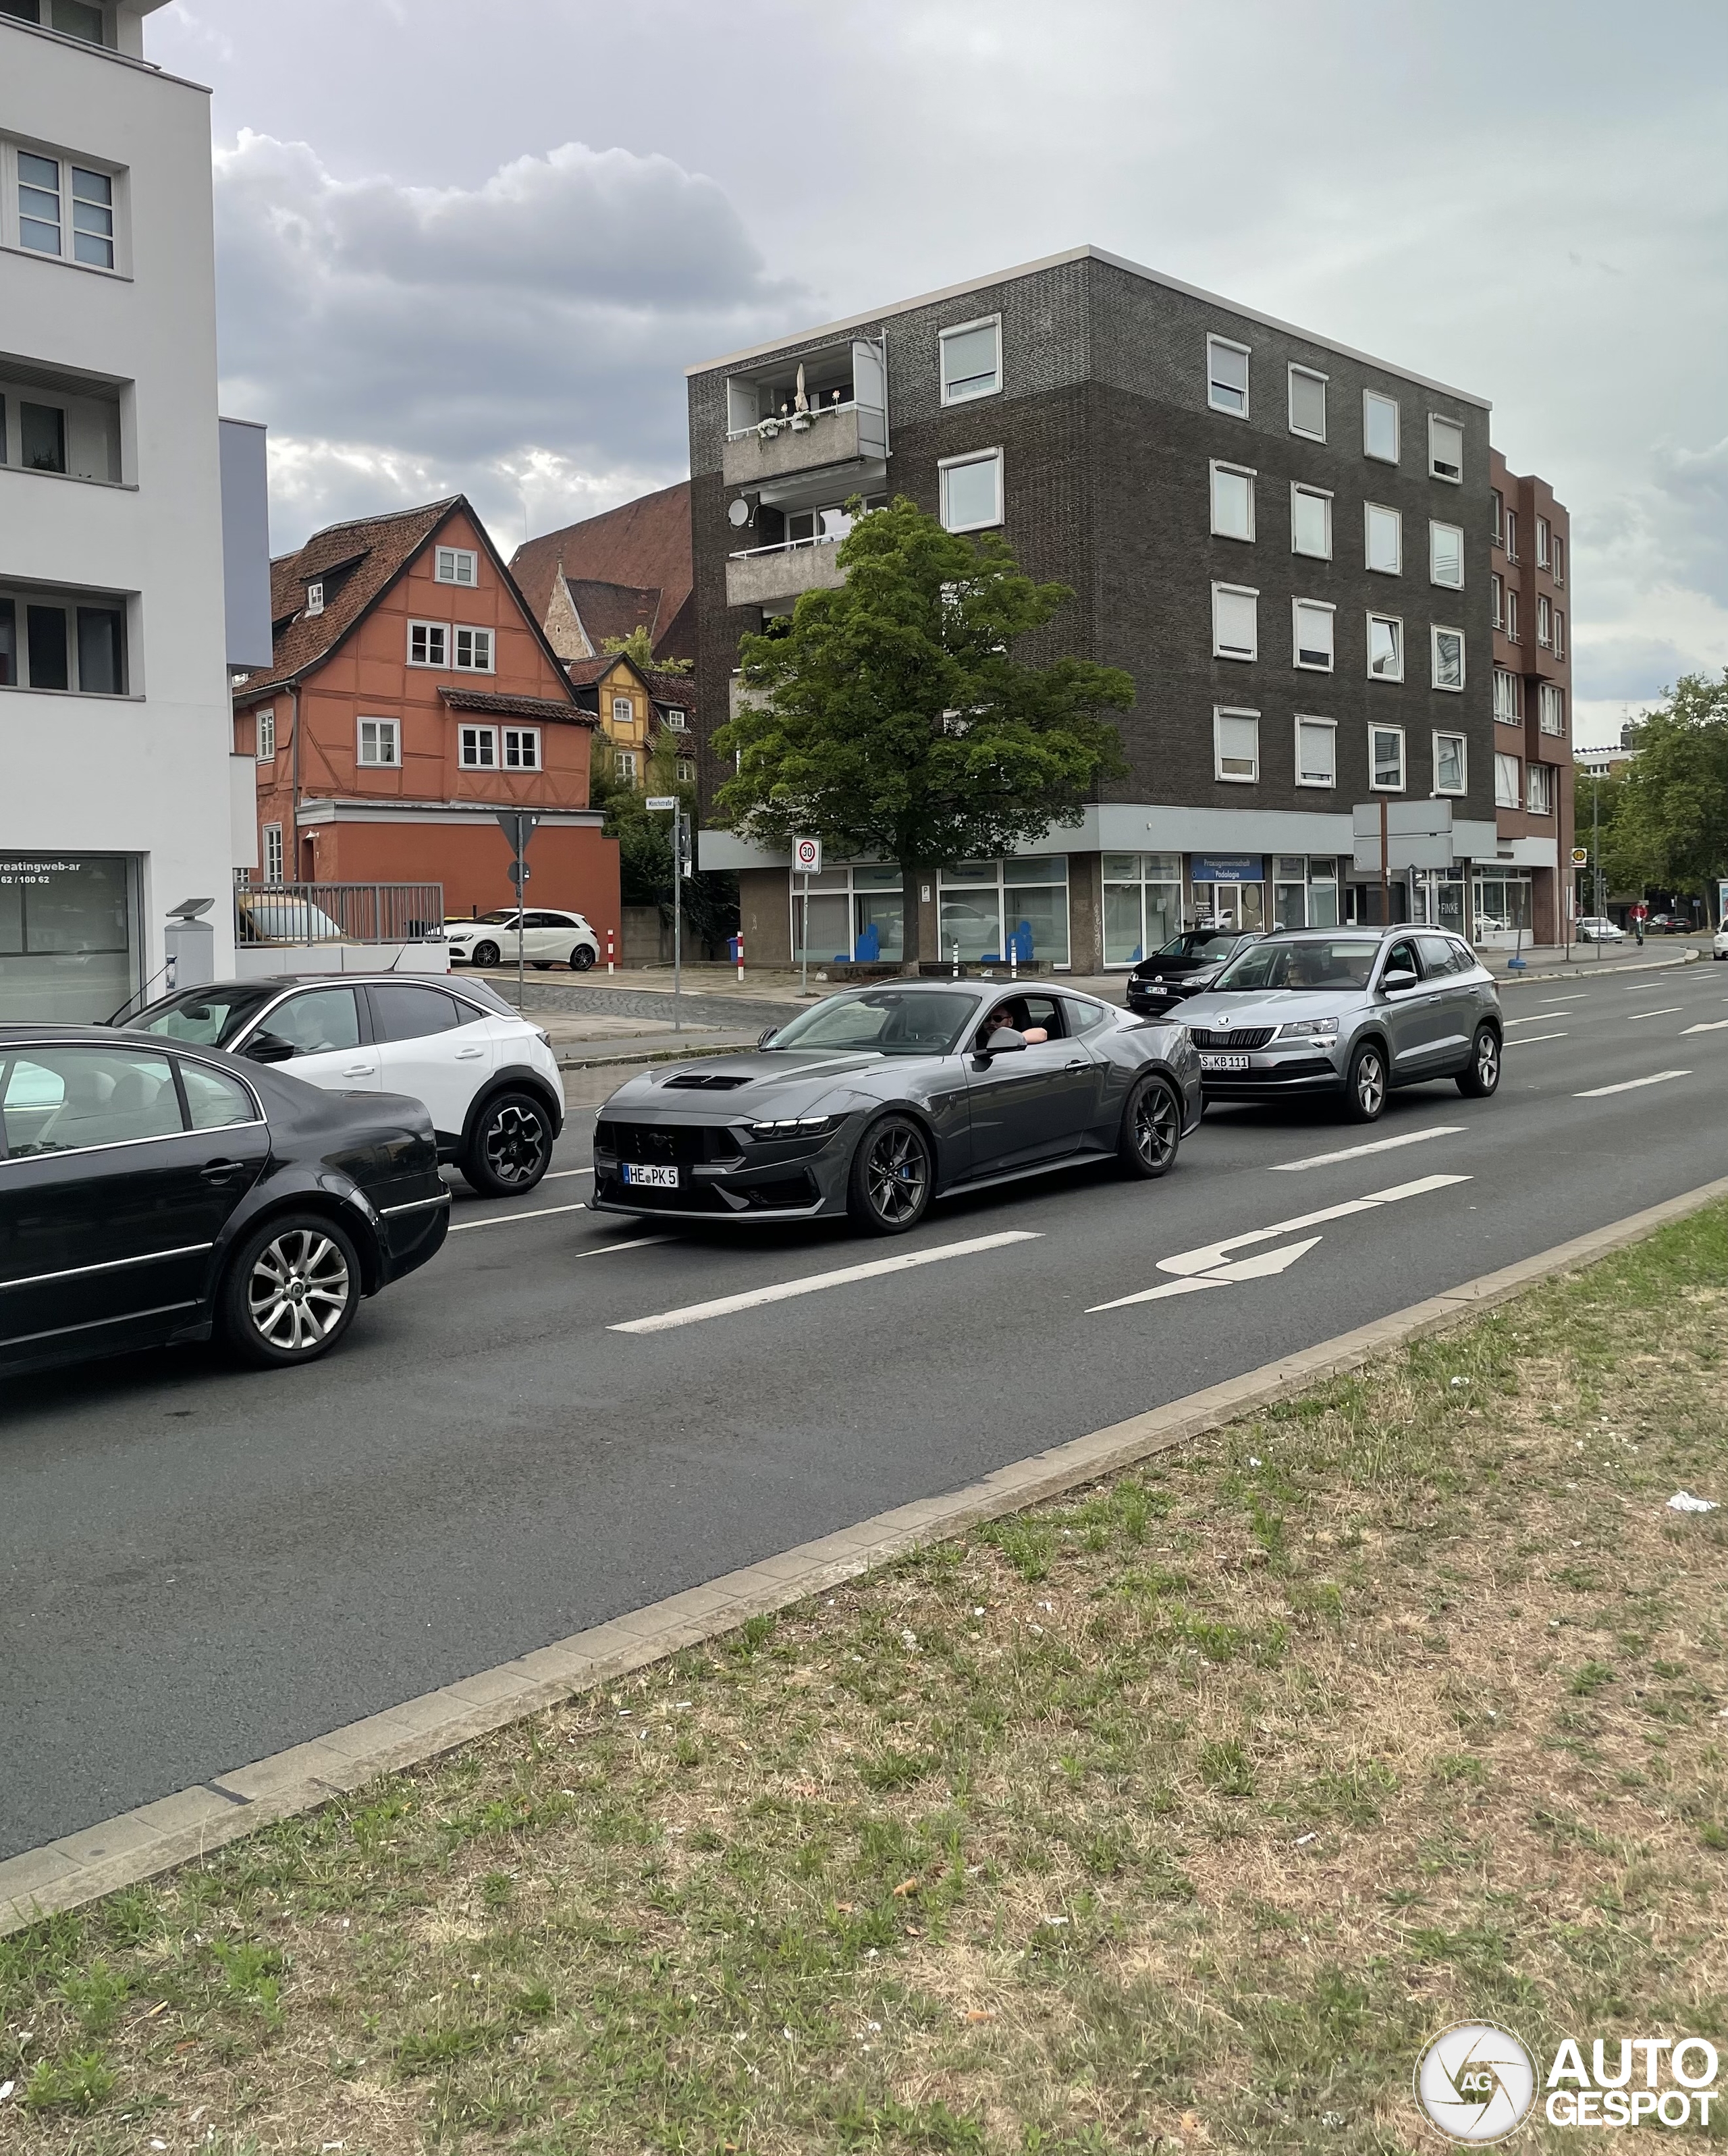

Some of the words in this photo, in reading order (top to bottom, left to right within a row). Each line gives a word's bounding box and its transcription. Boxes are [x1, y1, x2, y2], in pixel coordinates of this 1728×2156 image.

[802, 846, 812, 857] 30
[1204, 859, 1250, 868] Praxisgemeinschaft
[1, 875, 13, 884] 62
[20, 875, 36, 884] 100
[38, 875, 50, 884] 62
[1215, 870, 1240, 880] Podologie
[1441, 902, 1459, 914] FINKE
[1214, 1056, 1226, 1067] KB
[1228, 1056, 1247, 1067] 111
[630, 1167, 645, 1183] HE
[651, 1168, 666, 1185] PK
[668, 1170, 676, 1184] 5
